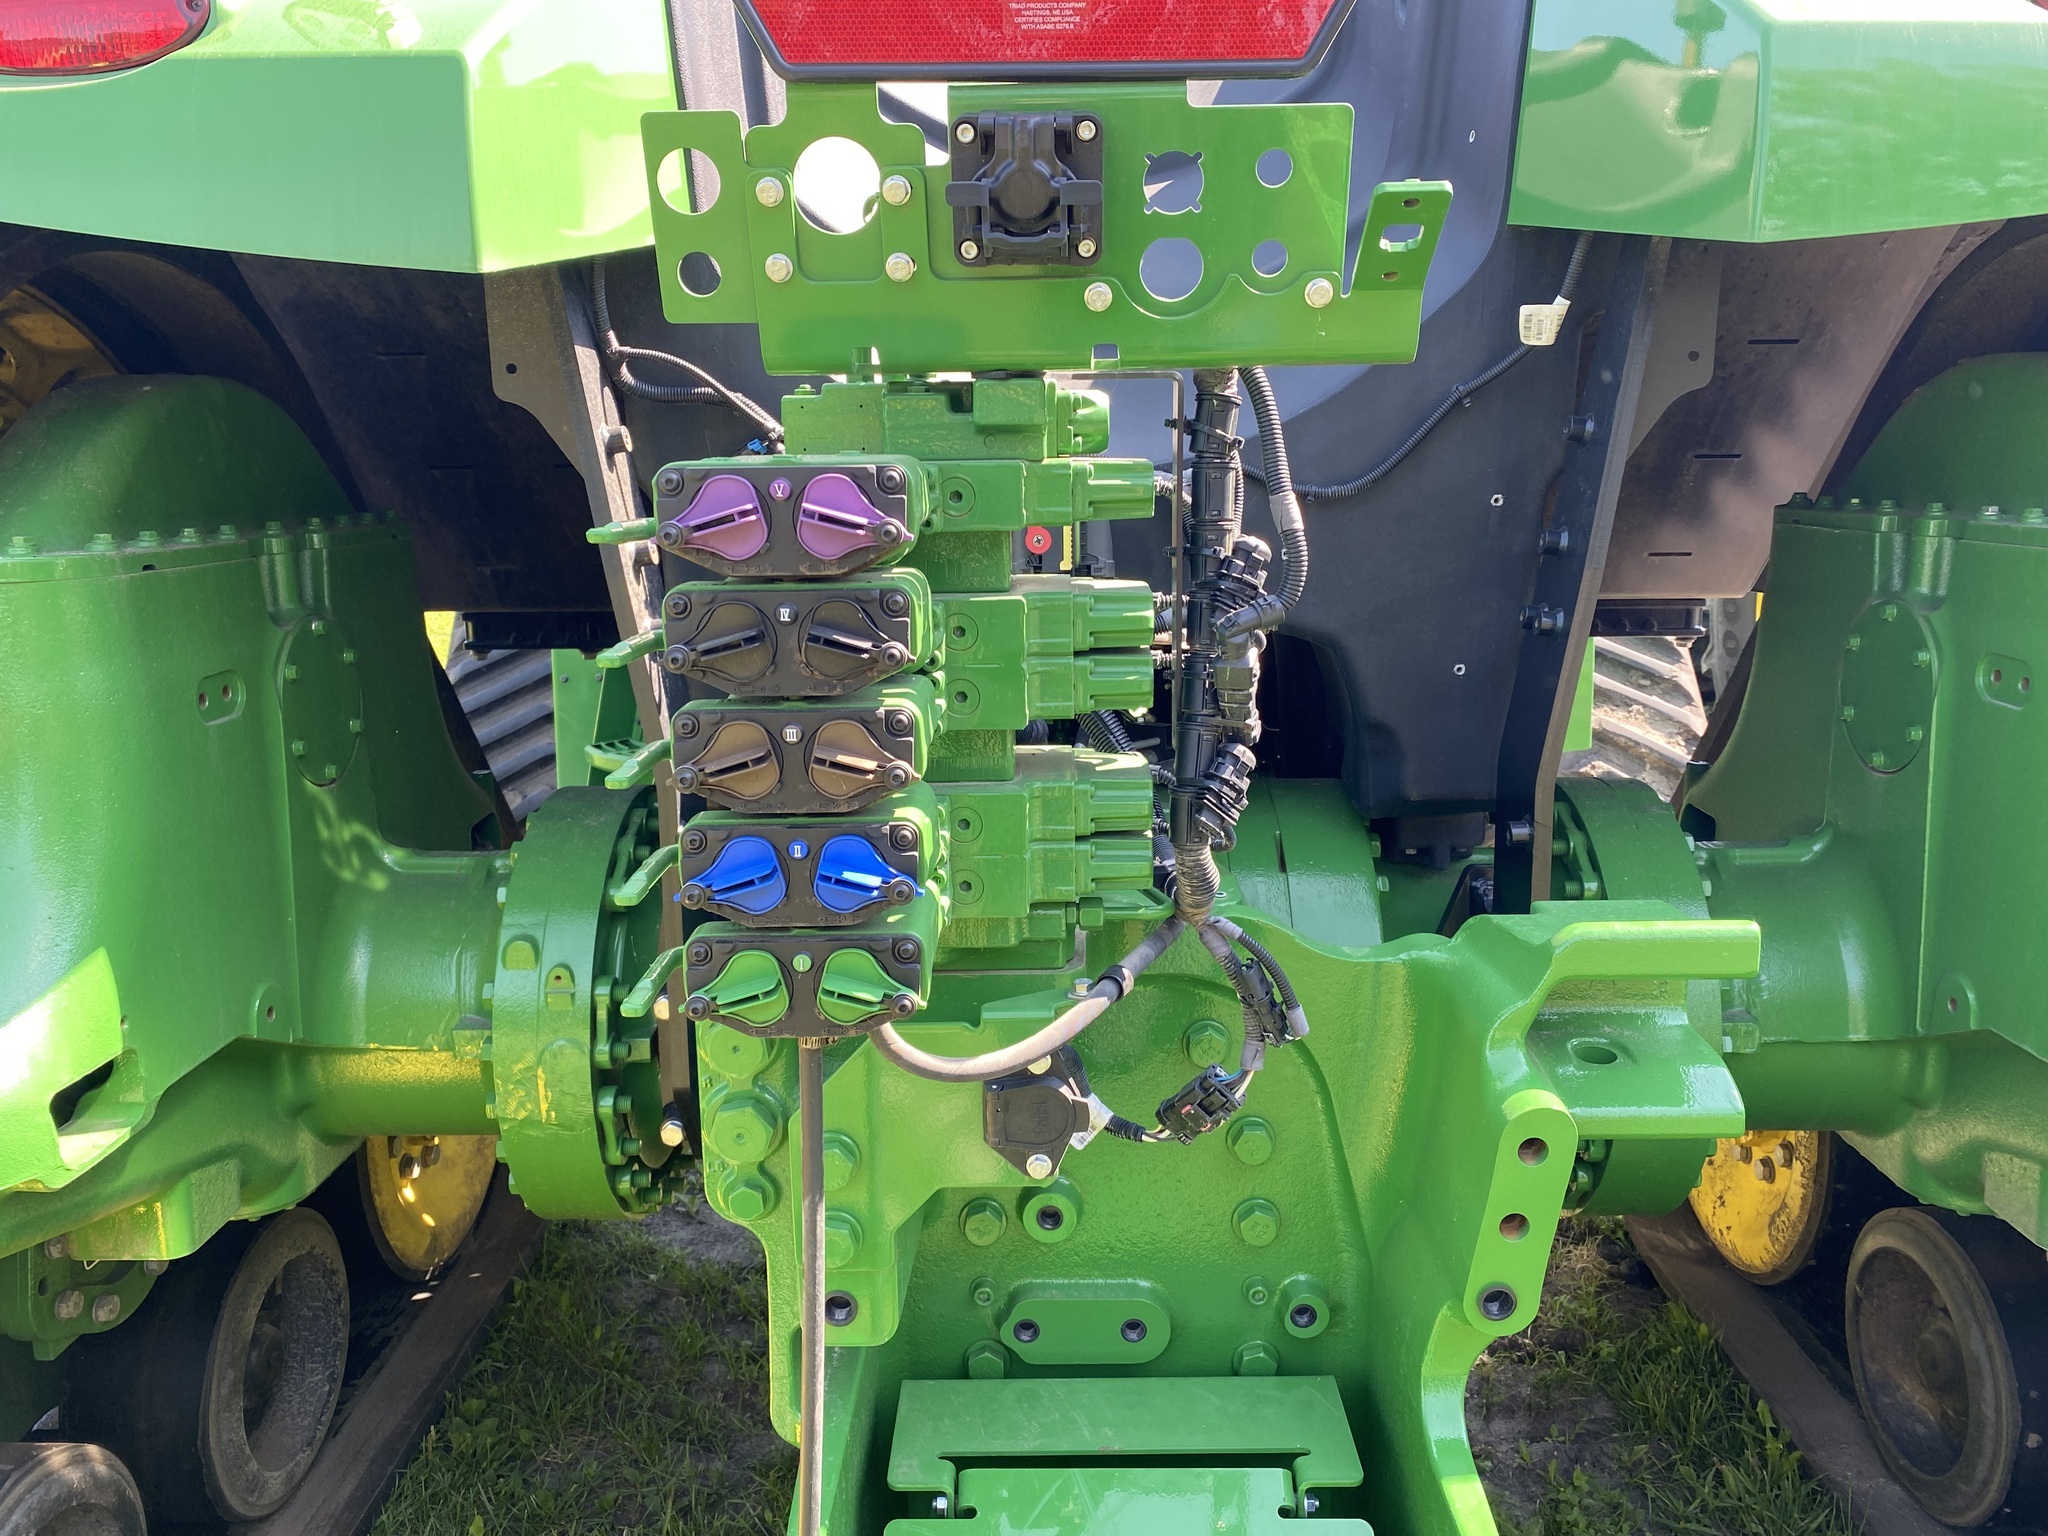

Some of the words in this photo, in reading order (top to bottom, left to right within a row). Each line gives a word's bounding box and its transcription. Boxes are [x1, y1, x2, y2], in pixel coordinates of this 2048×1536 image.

[774, 483, 784, 497] V
[779, 608, 791, 622] IV
[785, 728, 798, 742] III
[794, 845, 802, 857] II
